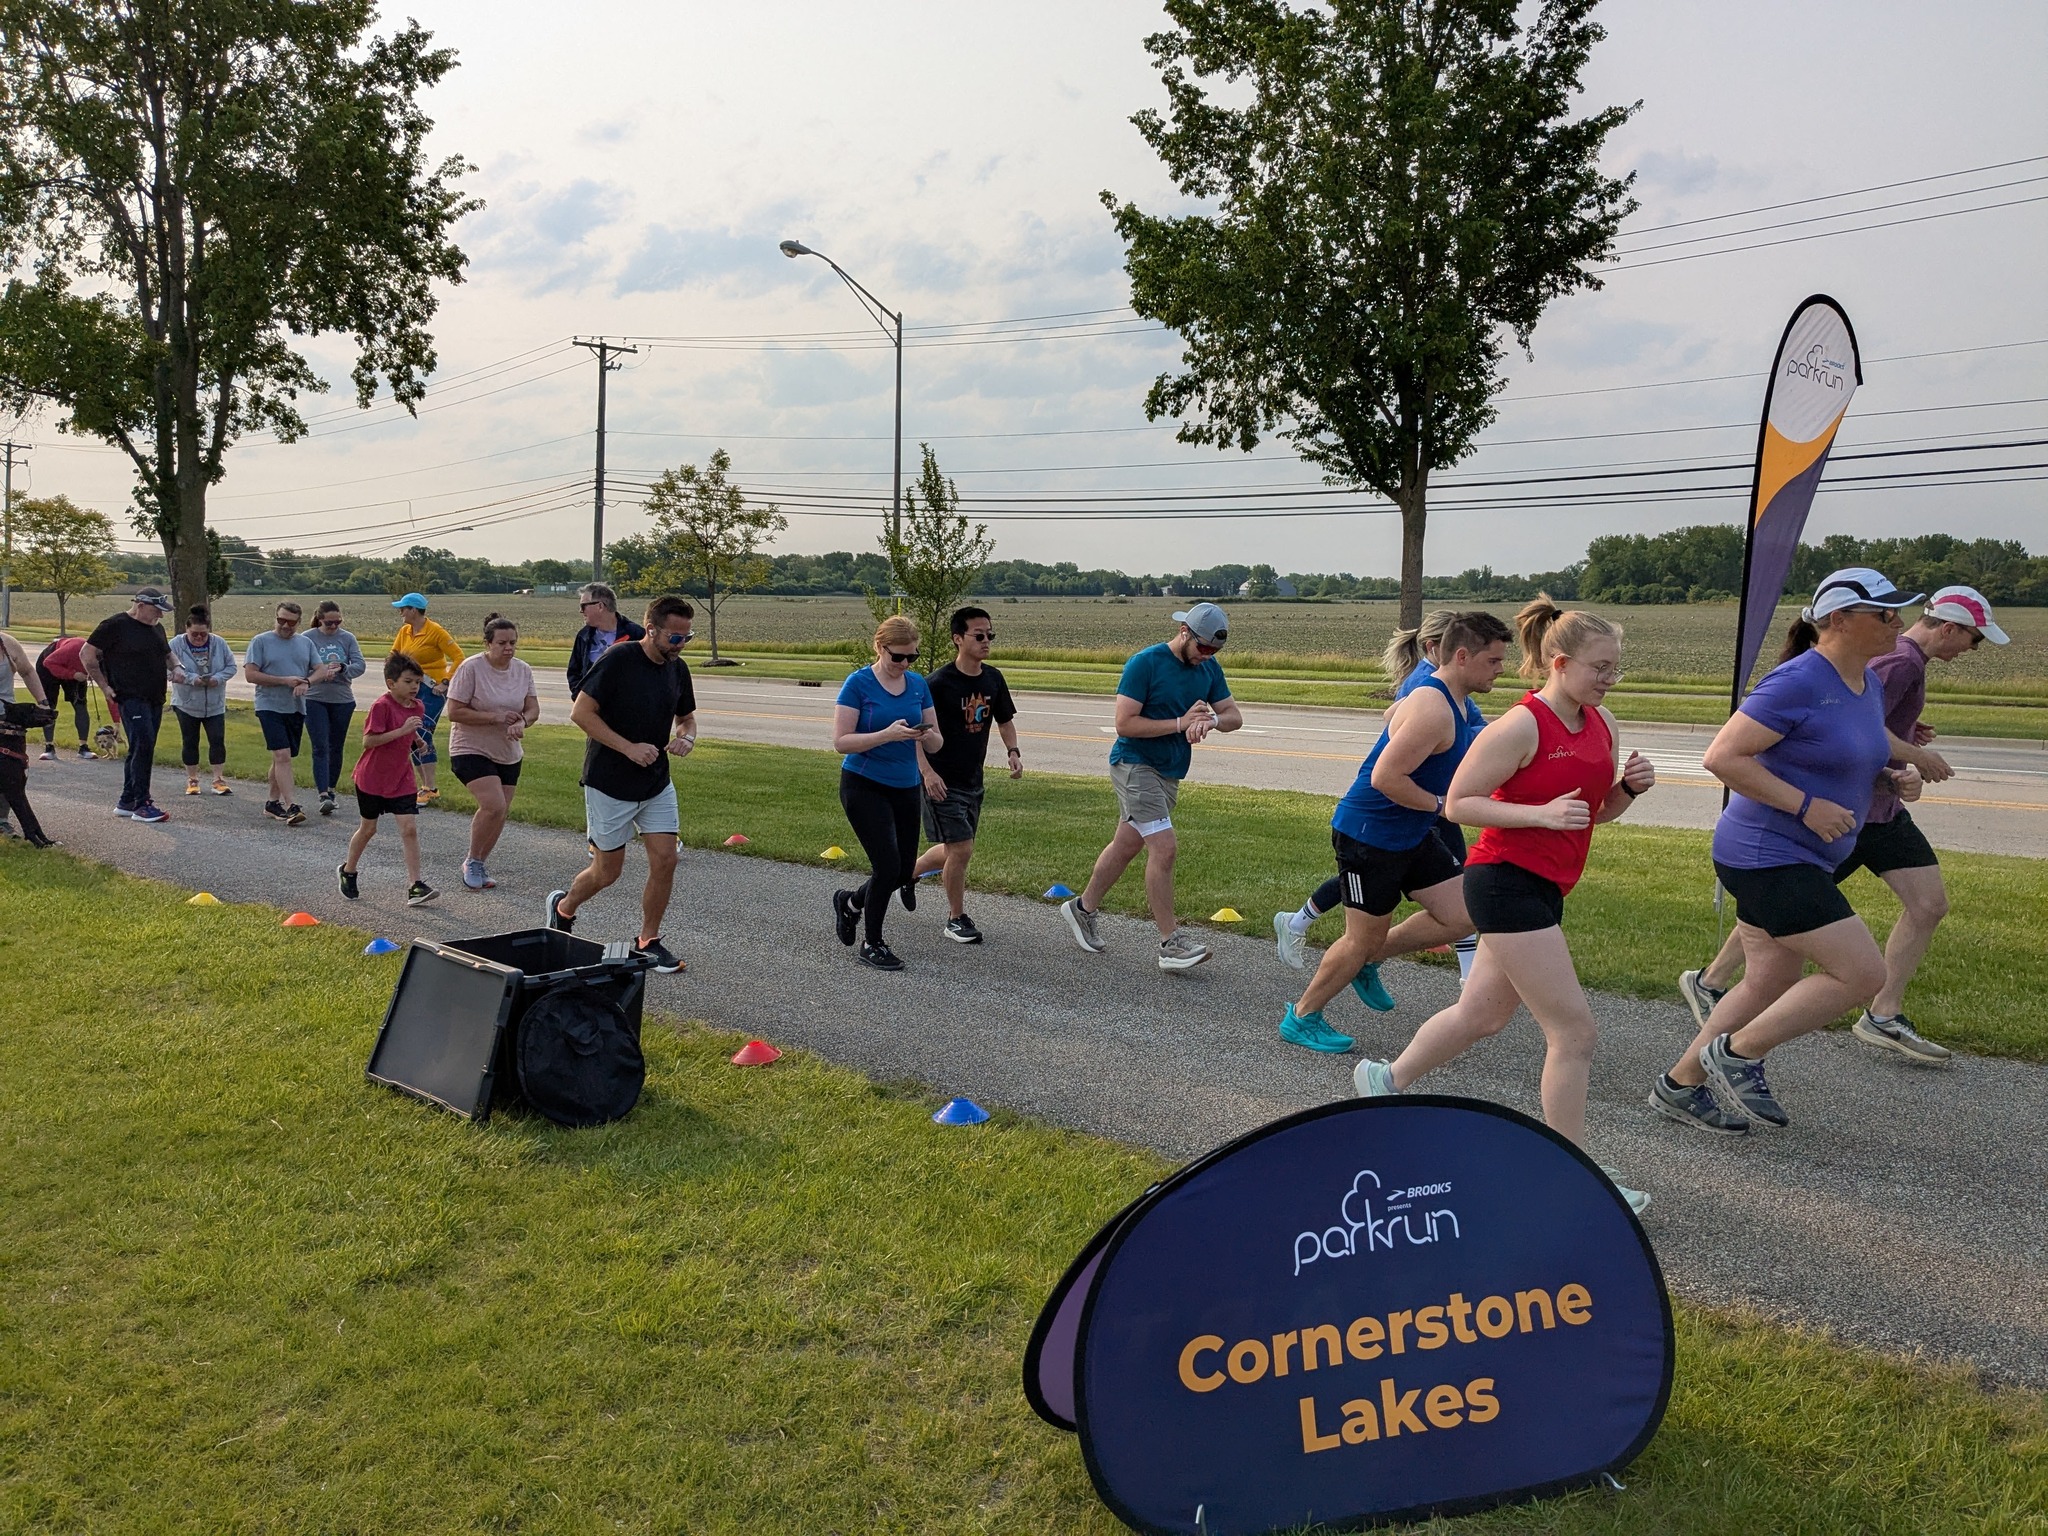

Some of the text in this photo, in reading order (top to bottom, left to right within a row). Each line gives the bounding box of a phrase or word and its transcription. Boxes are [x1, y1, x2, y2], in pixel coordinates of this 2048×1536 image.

[1786, 357, 1843, 391] parkrun
[1548, 749, 1577, 760] parkrun
[1387, 1202, 1412, 1212] presents
[1407, 1182, 1452, 1198] BROOKS
[1294, 1199, 1460, 1277] parkrun
[1178, 1283, 1593, 1393] Cornerstone
[1300, 1377, 1500, 1454] Lakes
